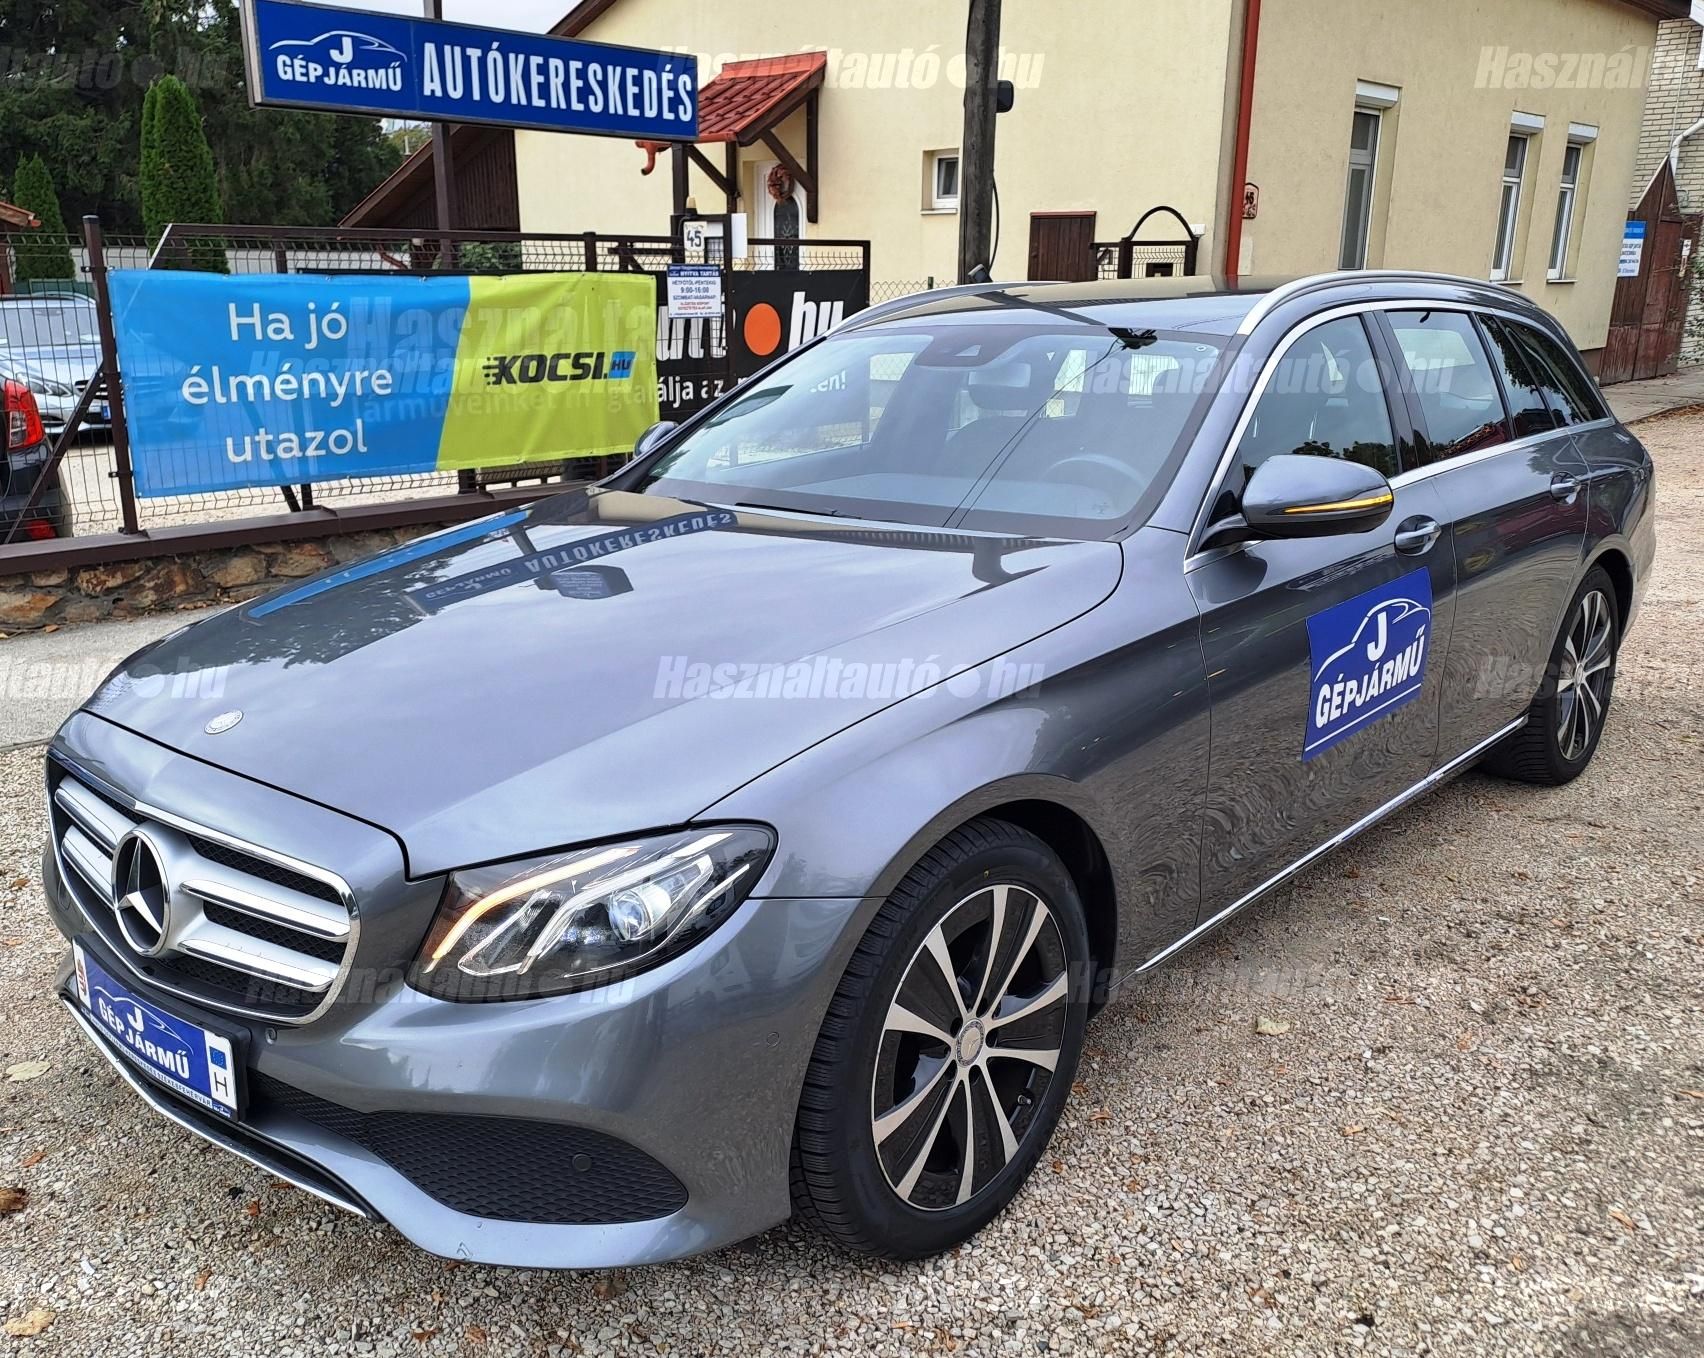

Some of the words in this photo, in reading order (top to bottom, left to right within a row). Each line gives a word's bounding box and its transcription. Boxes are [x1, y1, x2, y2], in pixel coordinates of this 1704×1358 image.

[277, 54, 402, 91] GÉPJÁRMŰ
[330, 36, 353, 64] J
[422, 41, 693, 122] AUTÓKERESKEDÉS
[686, 231, 703, 248] 45
[228, 302, 294, 341] Ha
[304, 302, 348, 350] jó
[181, 363, 393, 408] élményre
[490, 351, 637, 386] KOCSI.HU
[226, 418, 368, 463] utazol
[1367, 611, 1388, 662] J
[1315, 624, 1426, 729] GÉPJÁRMŰ
[98, 997, 190, 1080] GÉPJÁRMŰ
[127, 1006, 145, 1032] J
[213, 1071, 229, 1098] H
